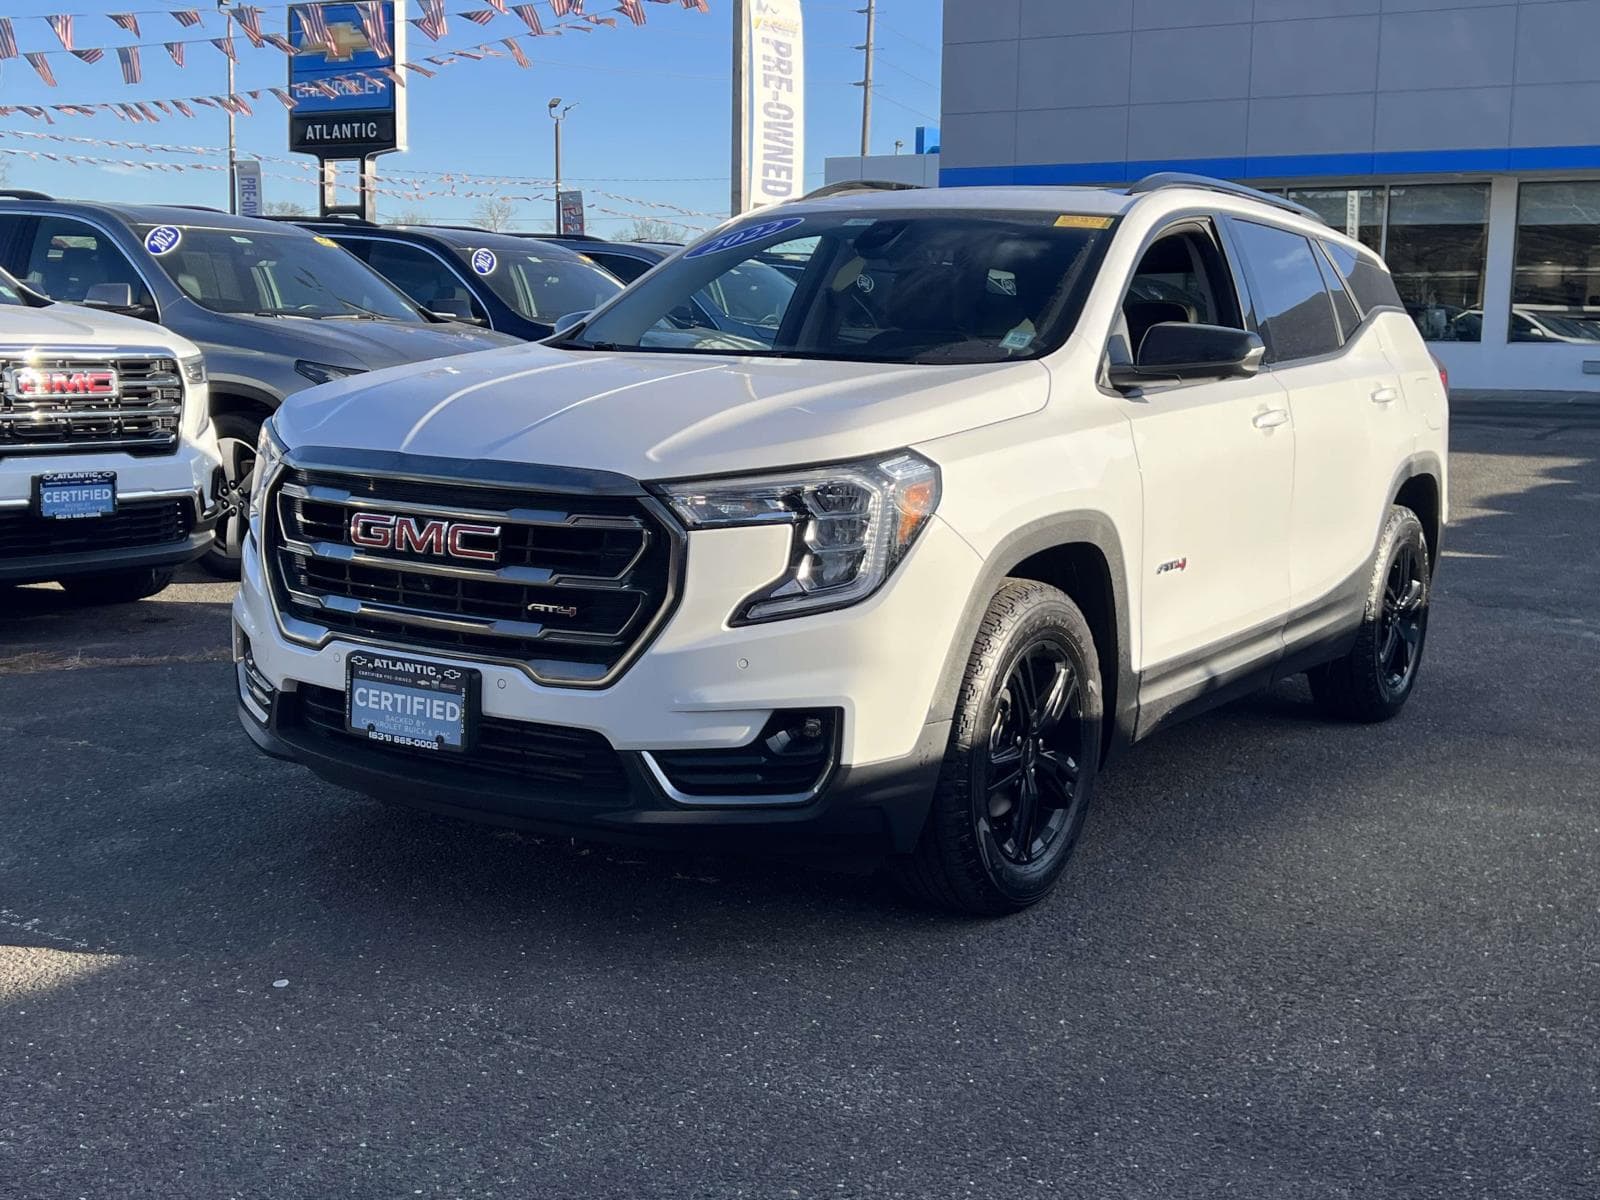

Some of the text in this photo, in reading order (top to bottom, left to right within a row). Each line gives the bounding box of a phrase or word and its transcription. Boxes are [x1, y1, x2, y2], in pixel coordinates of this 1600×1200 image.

[761, 36, 794, 197] PRE-OWNED
[306, 122, 377, 140] ATLANTIC
[150, 227, 176, 252] 2023
[702, 221, 784, 254] 2022
[18, 370, 114, 395] GMC
[57, 471, 98, 479] ATLANTIC
[43, 488, 112, 503] CERTIFIED
[350, 512, 501, 561] GMC
[527, 603, 577, 617] AT4
[373, 658, 437, 676] ATLANTIC
[354, 687, 460, 722] CERTIFIED
